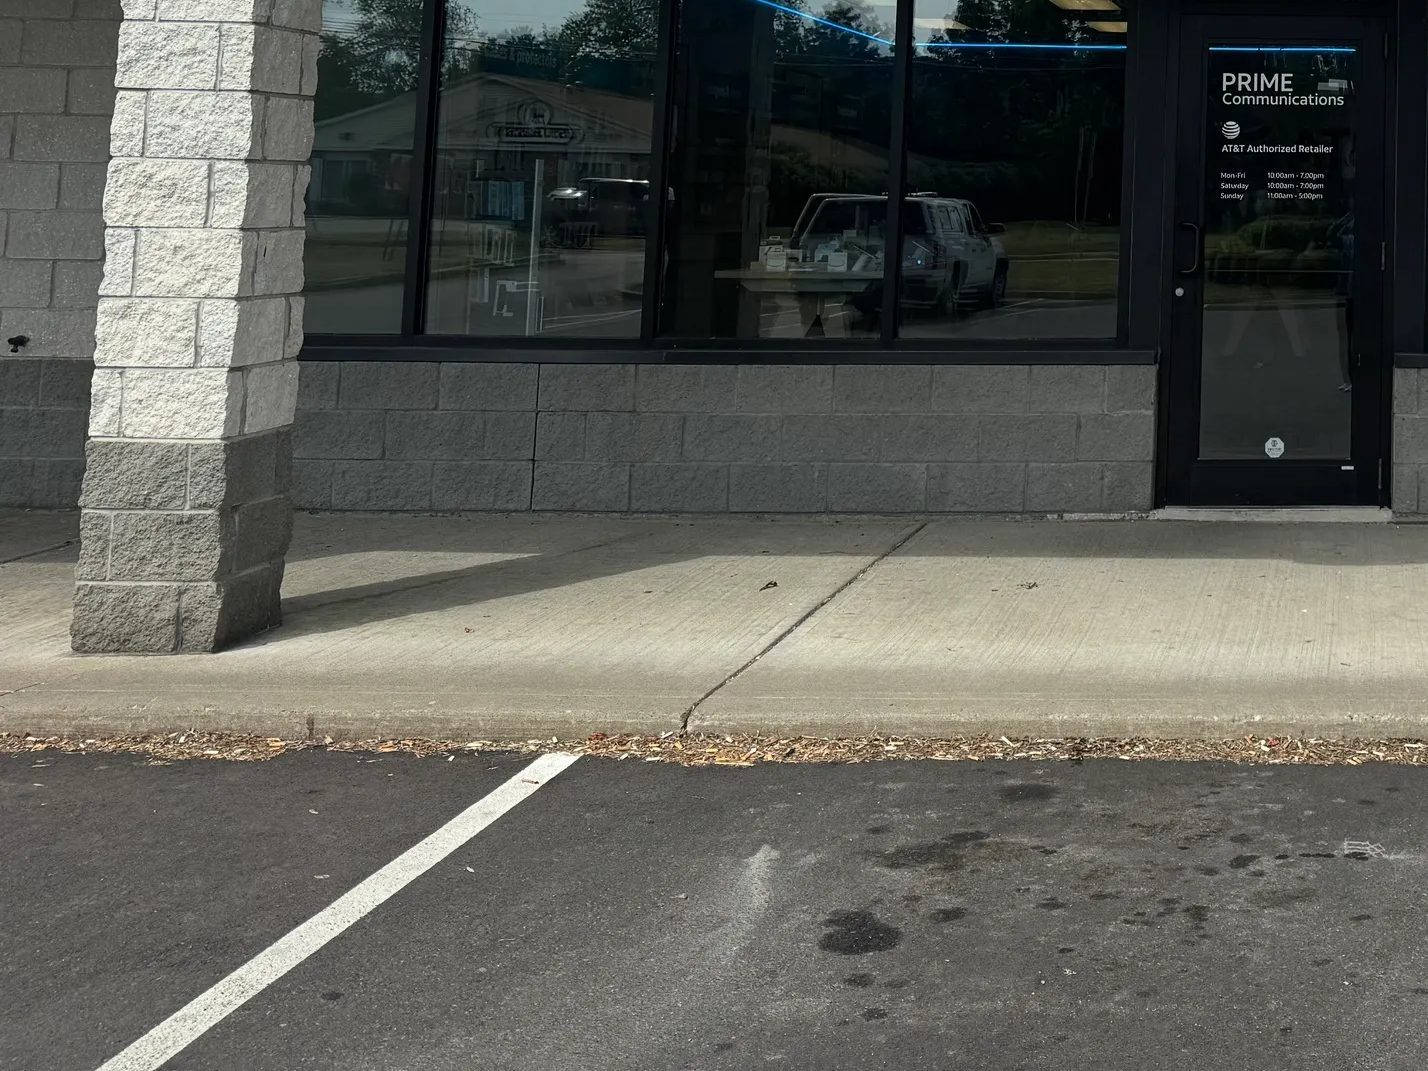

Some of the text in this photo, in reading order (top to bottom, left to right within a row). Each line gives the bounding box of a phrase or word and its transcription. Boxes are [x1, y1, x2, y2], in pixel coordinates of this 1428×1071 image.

[1222, 72, 1294, 91] PRIME
[1222, 92, 1345, 106] Communications
[1221, 144, 1334, 154] AT&T Authorized Retailer
[1220, 182, 1250, 191] Saturday
[1220, 192, 1245, 201] Sunday
